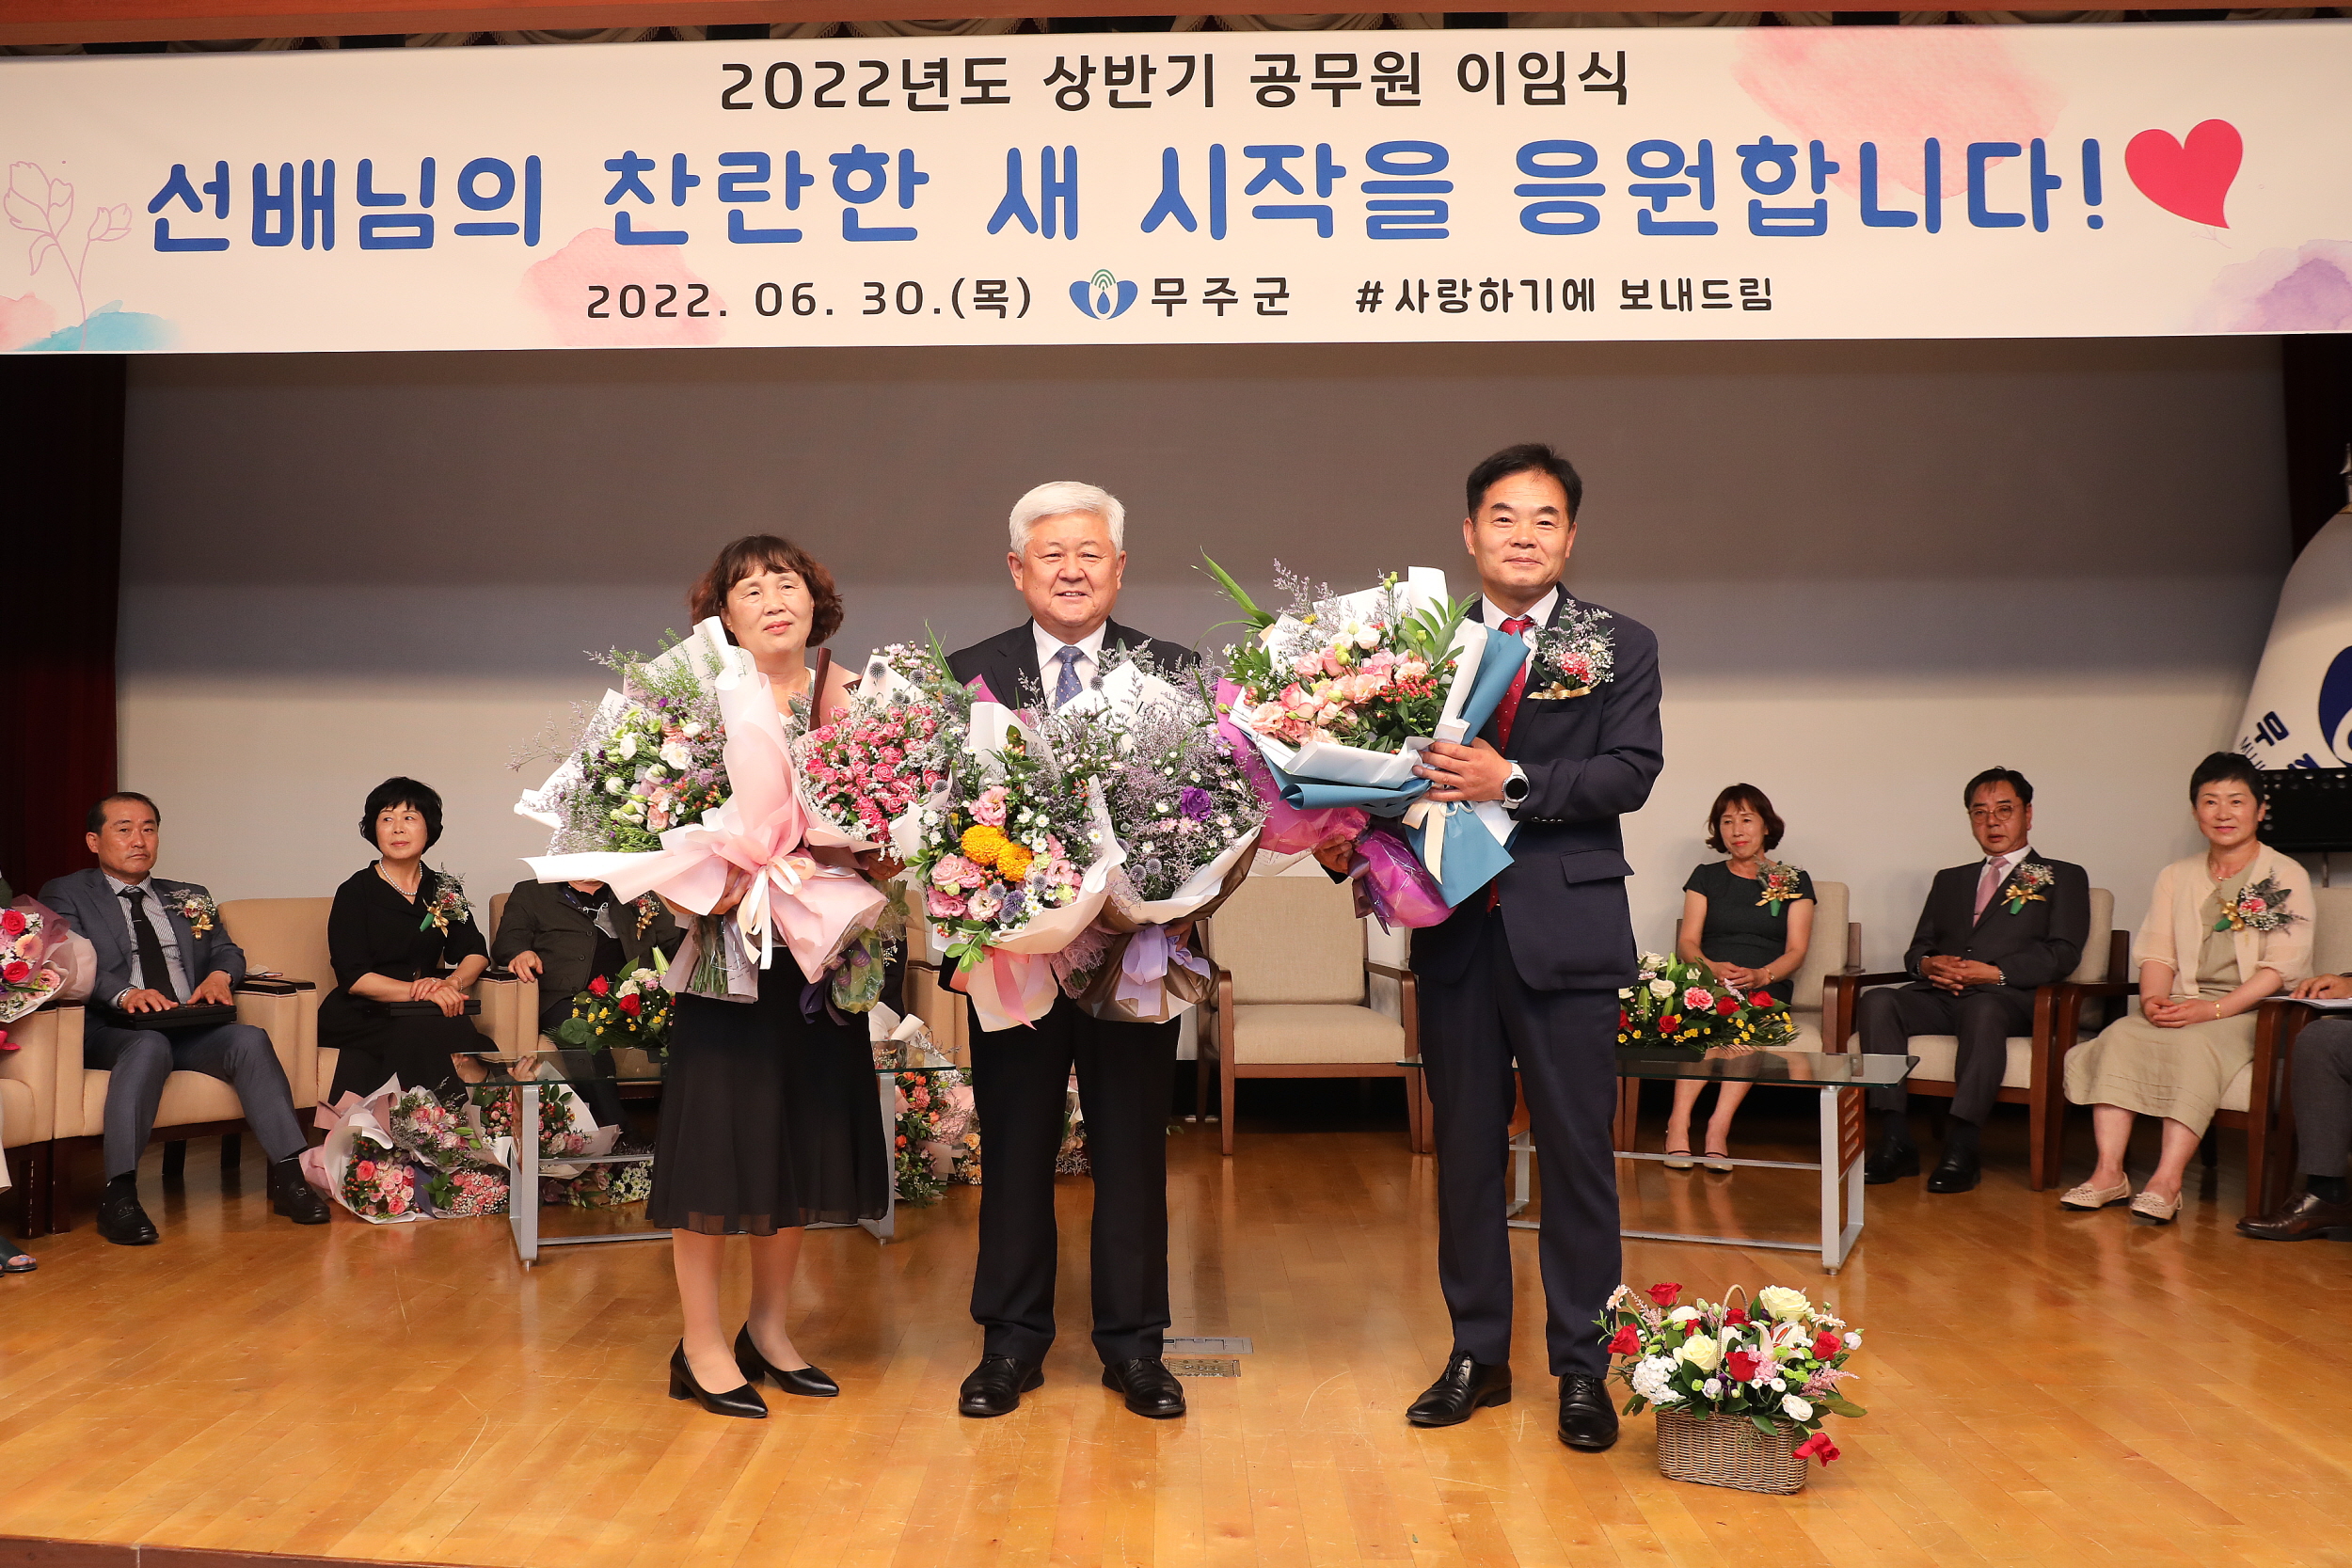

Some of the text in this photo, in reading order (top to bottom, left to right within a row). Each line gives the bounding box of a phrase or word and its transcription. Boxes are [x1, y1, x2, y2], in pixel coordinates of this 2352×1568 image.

[721, 50, 1629, 113] 2022년도 상반기 공무원 이임식
[146, 135, 2105, 253] 선배님의 찬란한 새 시작을 응원합니다!
[586, 276, 1032, 320] 2022. 06. 30.(목)
[1151, 277, 1291, 318] 무주군
[1618, 277, 1772, 312] 보내드림
